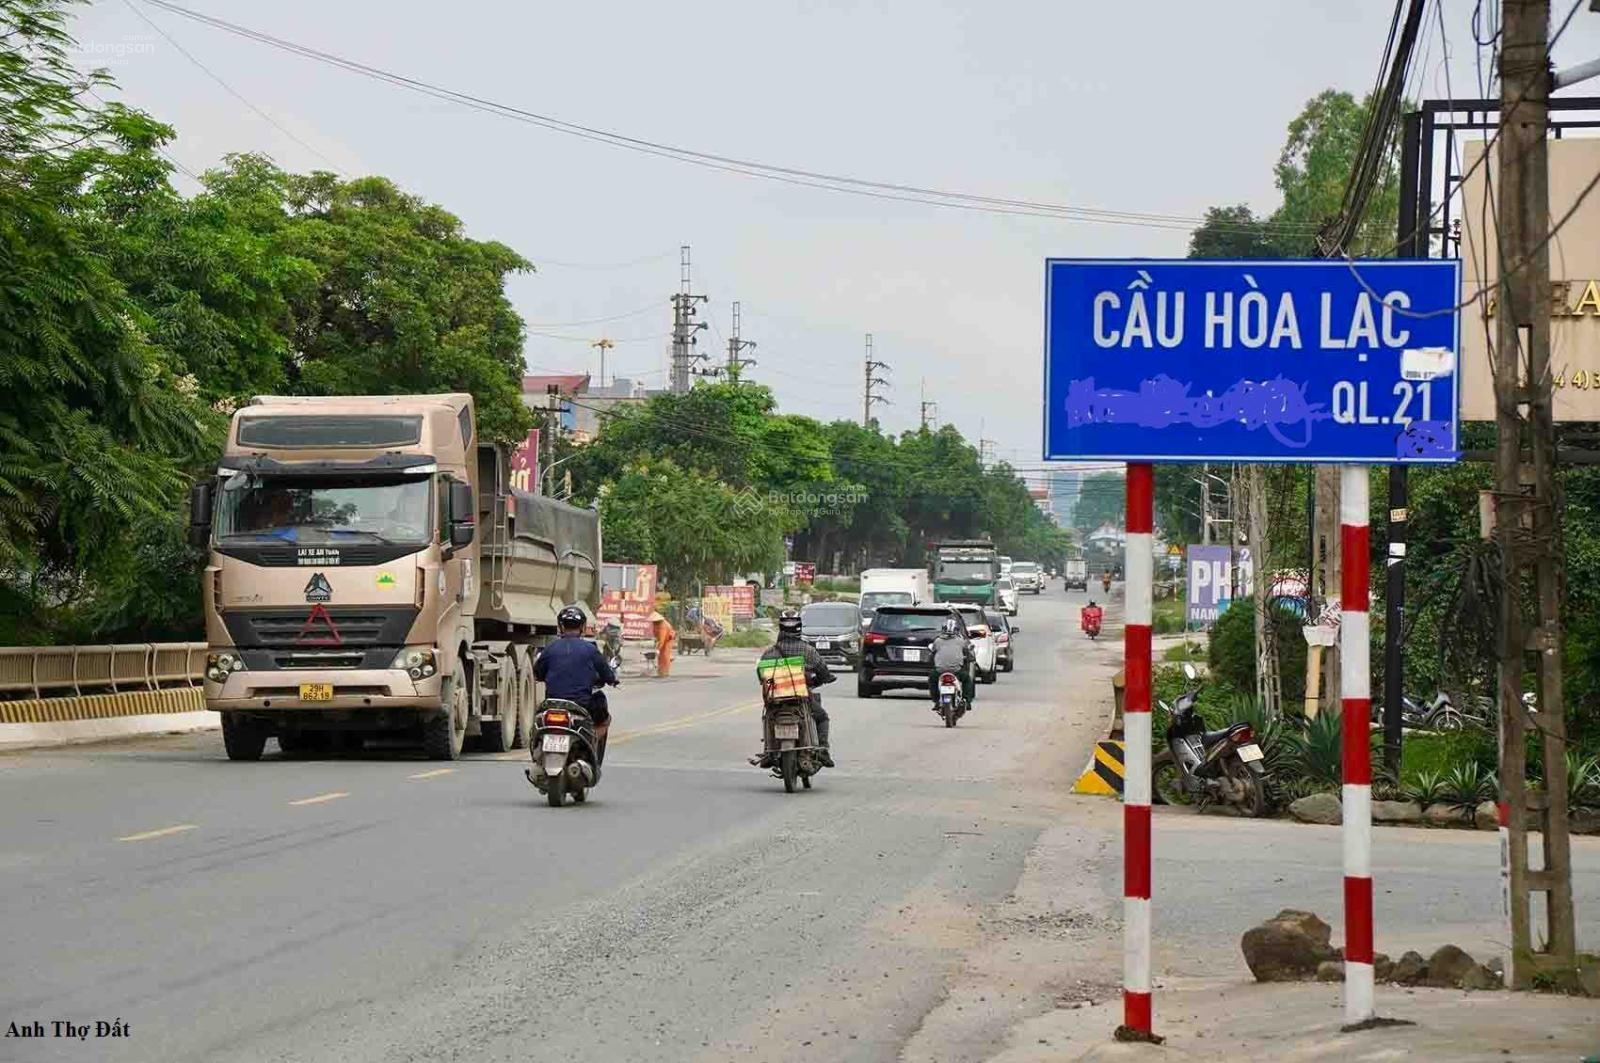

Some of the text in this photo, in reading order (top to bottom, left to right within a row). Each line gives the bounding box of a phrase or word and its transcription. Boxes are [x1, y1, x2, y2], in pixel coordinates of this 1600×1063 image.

[1093, 270, 1411, 361] CẦU HÒA LẠC
[1332, 381, 1432, 424] QL.21
